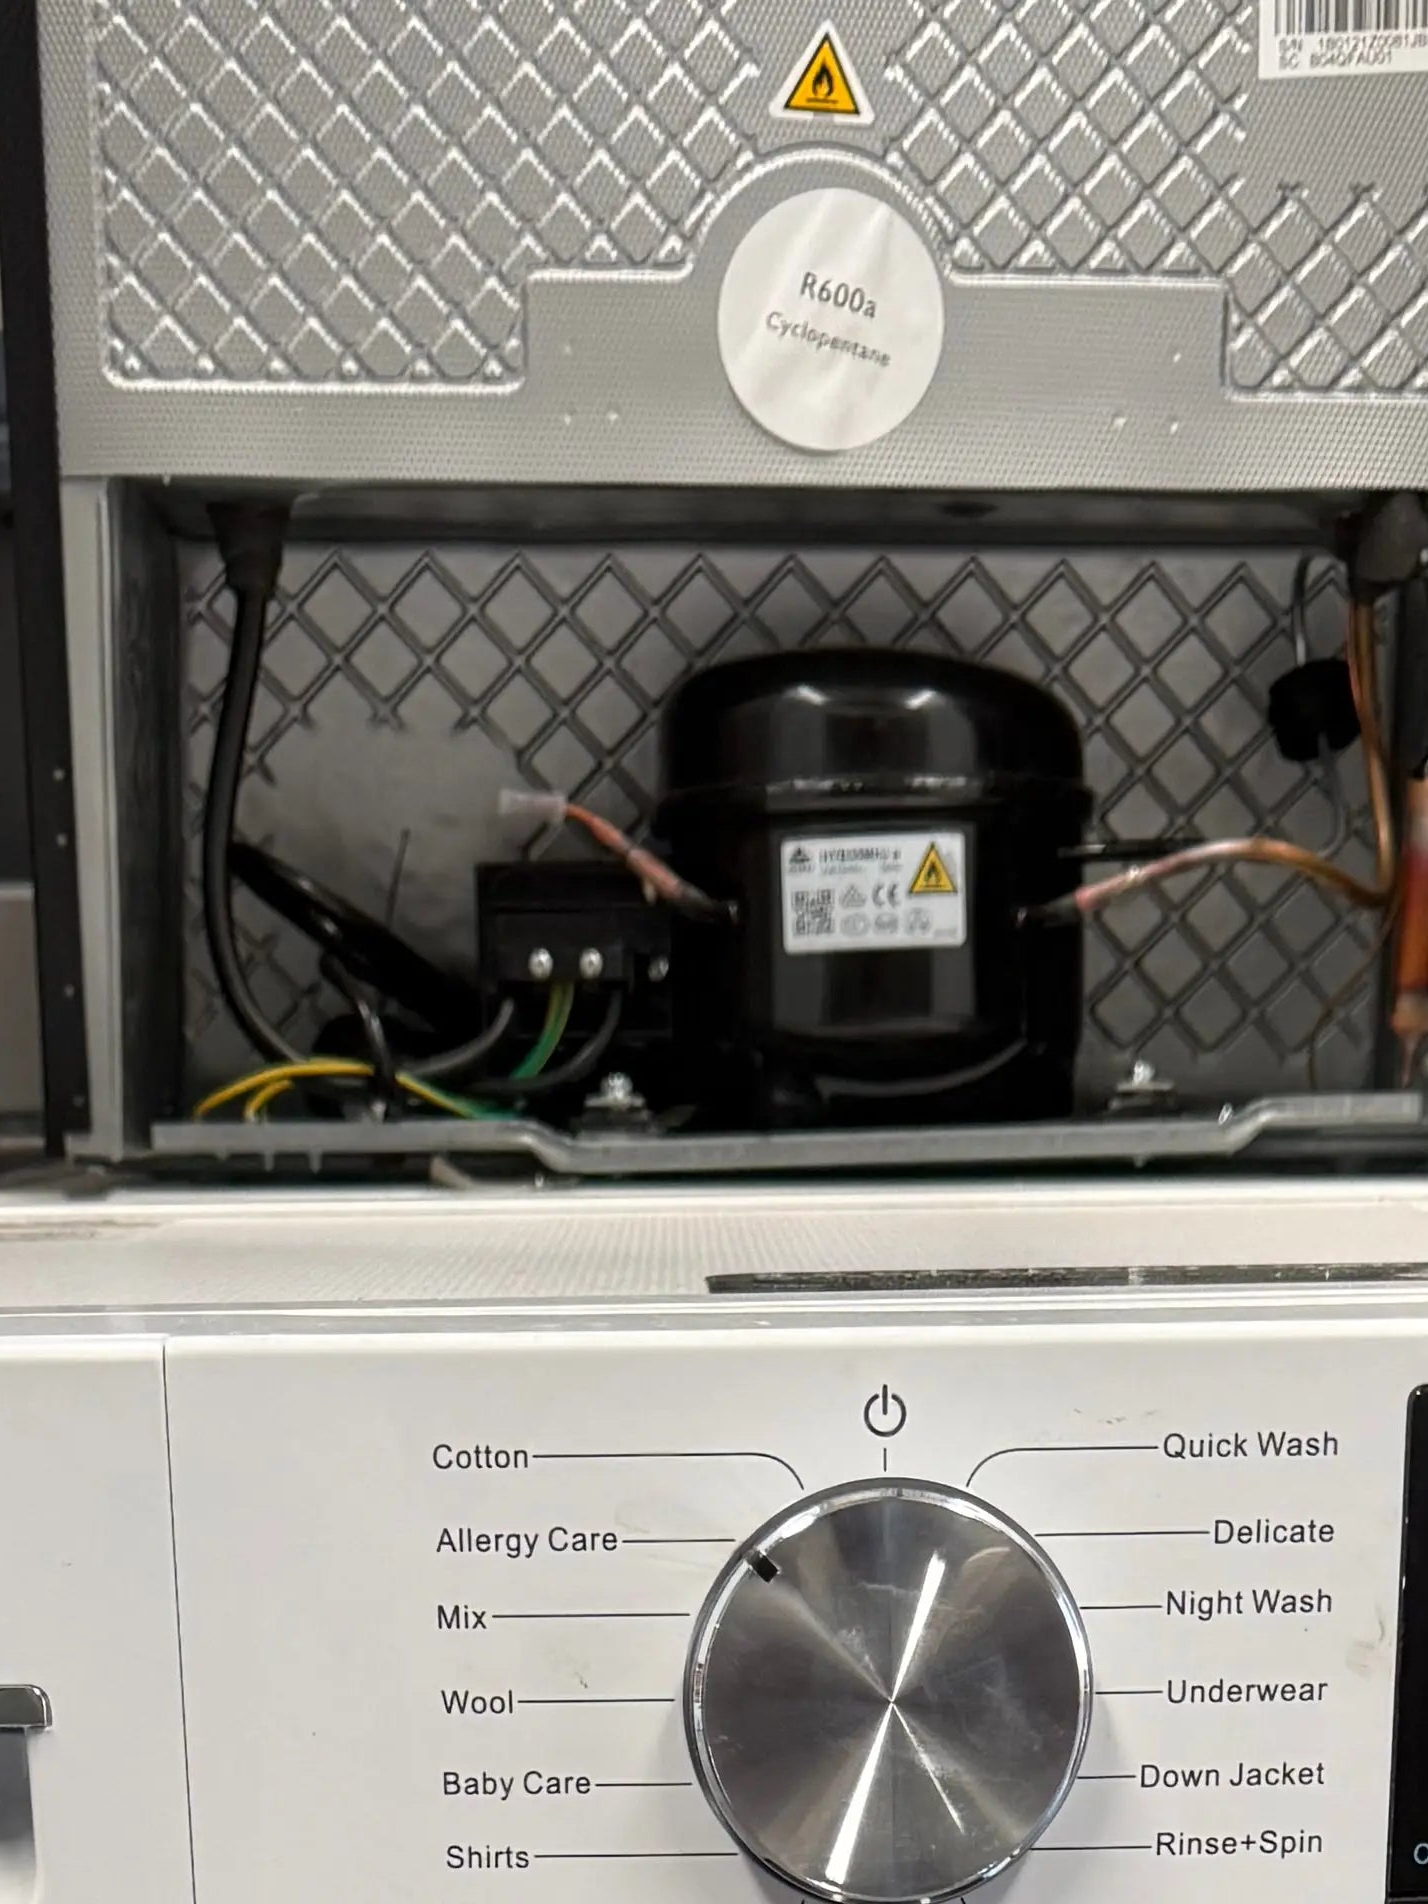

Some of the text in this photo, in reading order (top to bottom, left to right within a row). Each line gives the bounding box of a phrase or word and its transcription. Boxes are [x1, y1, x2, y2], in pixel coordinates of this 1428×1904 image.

[800, 271, 878, 319] R600a
[765, 310, 891, 368] Cyclopentane
[432, 1443, 529, 1471] Cotton
[1162, 1430, 1339, 1461] Quick Wash
[435, 1525, 619, 1560] Allergy Care
[1213, 1518, 1335, 1546] Delicate
[436, 1603, 488, 1631] Mix
[1165, 1587, 1333, 1623] Night Wash
[440, 1688, 514, 1716] Wool
[1167, 1677, 1329, 1705] Underwear
[442, 1769, 592, 1802] Baby Care
[1139, 1761, 1325, 1789] Down Jacket
[445, 1844, 530, 1870] Shirts
[1155, 1828, 1323, 1860] Rinse+Spin
